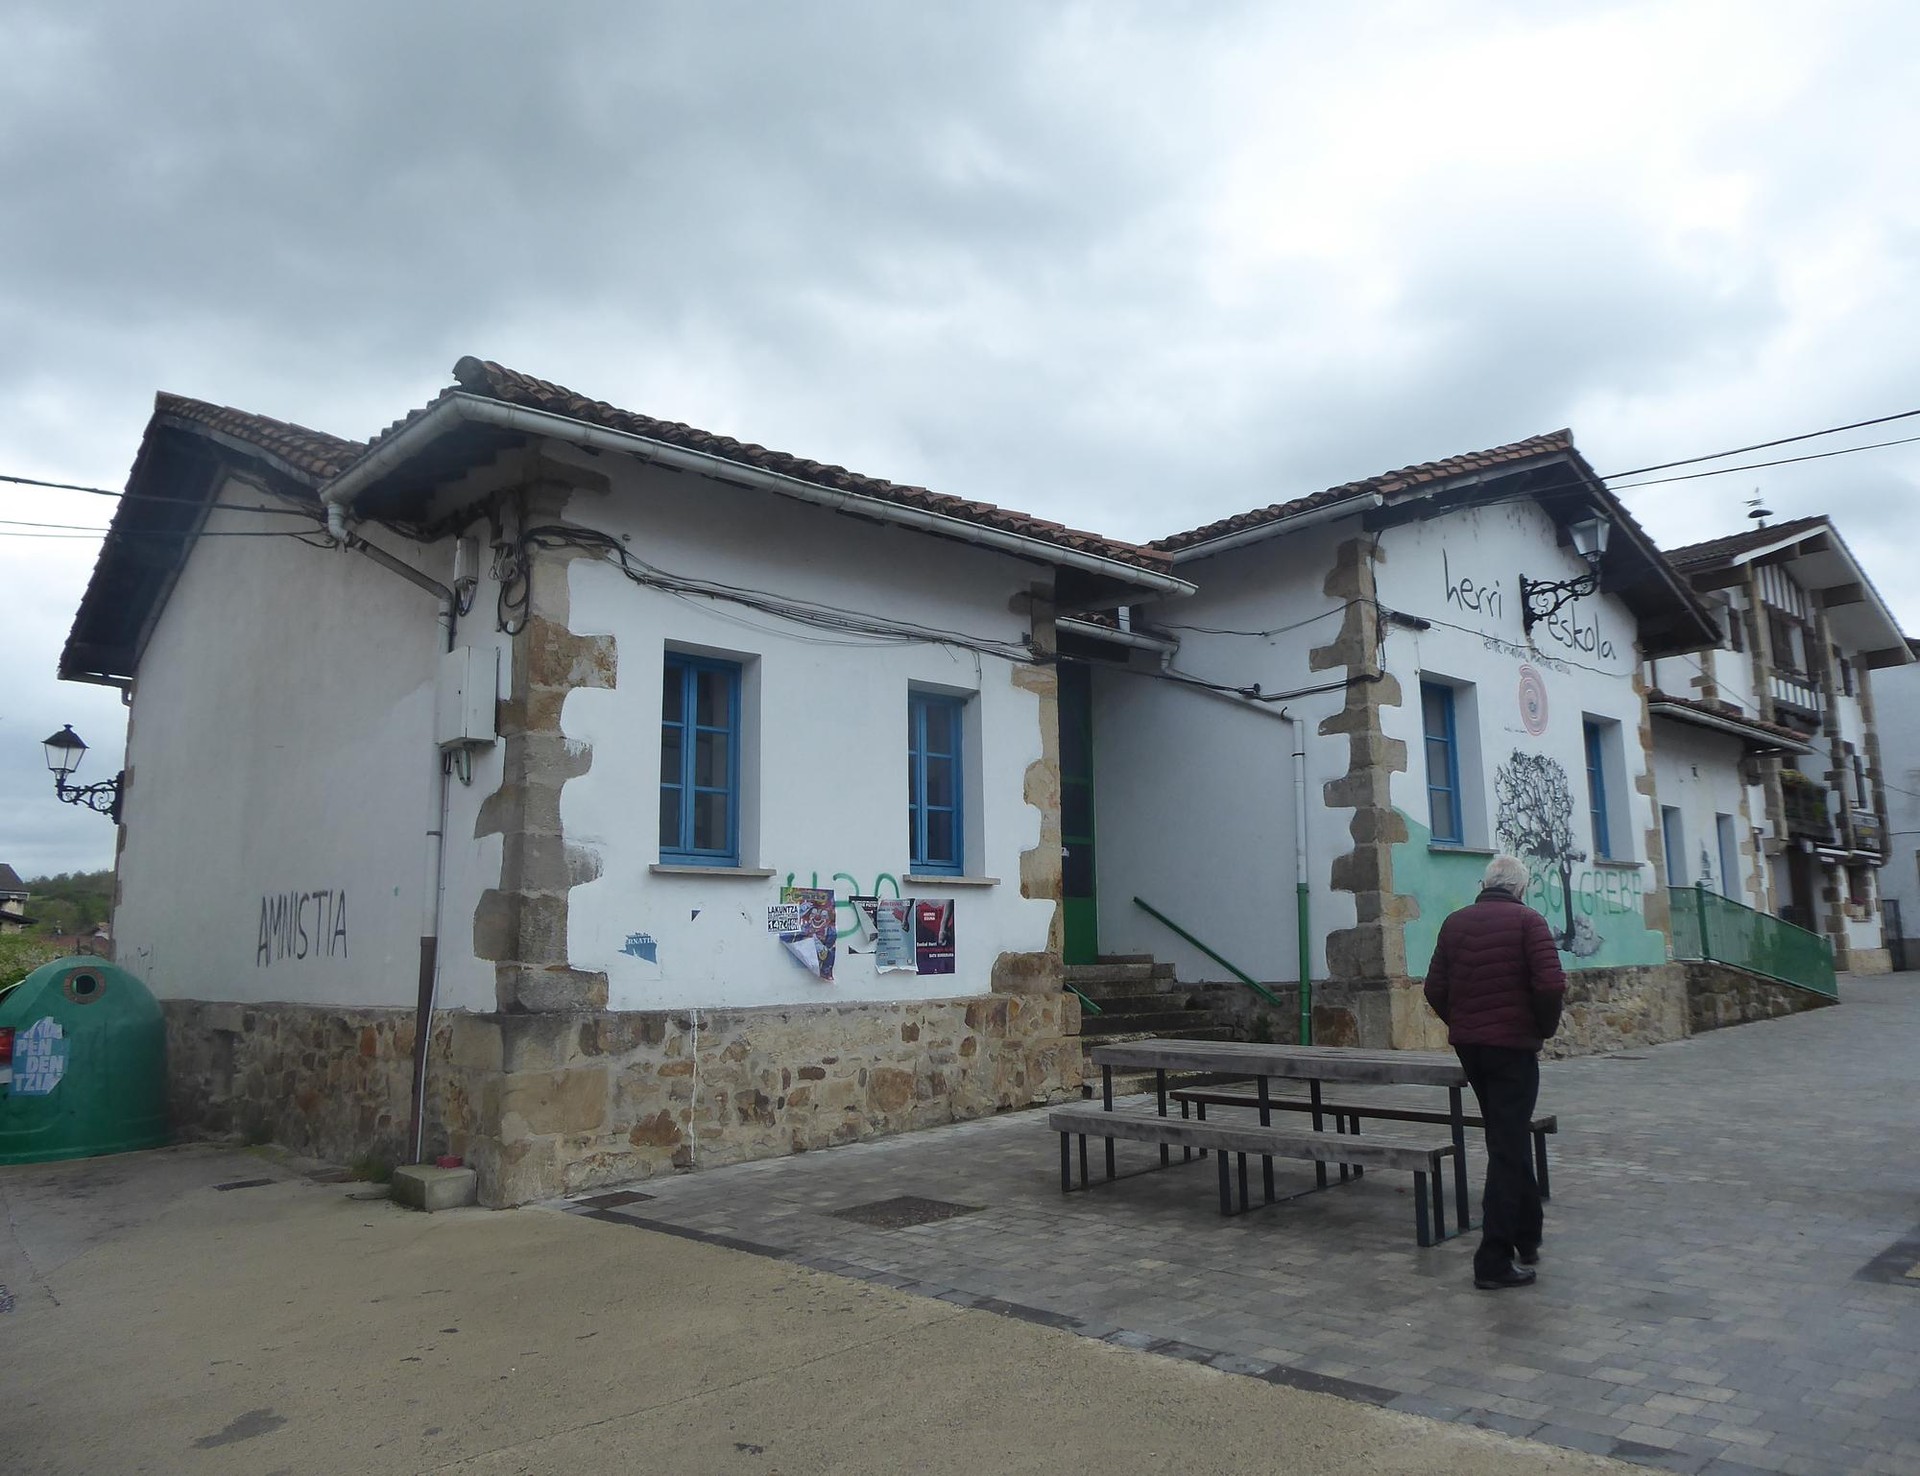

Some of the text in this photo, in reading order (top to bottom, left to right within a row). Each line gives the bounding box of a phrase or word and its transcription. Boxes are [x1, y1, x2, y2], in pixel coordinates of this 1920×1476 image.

[1442, 548, 1502, 620] herri
[1547, 600, 1617, 661] eskola
[767, 905, 798, 914] LAKUNTZA
[1526, 868, 1642, 918] 30 GREBA
[256, 888, 348, 968] AMNISTIA
[15, 1039, 53, 1056] PEN
[25, 1055, 65, 1073] DEN
